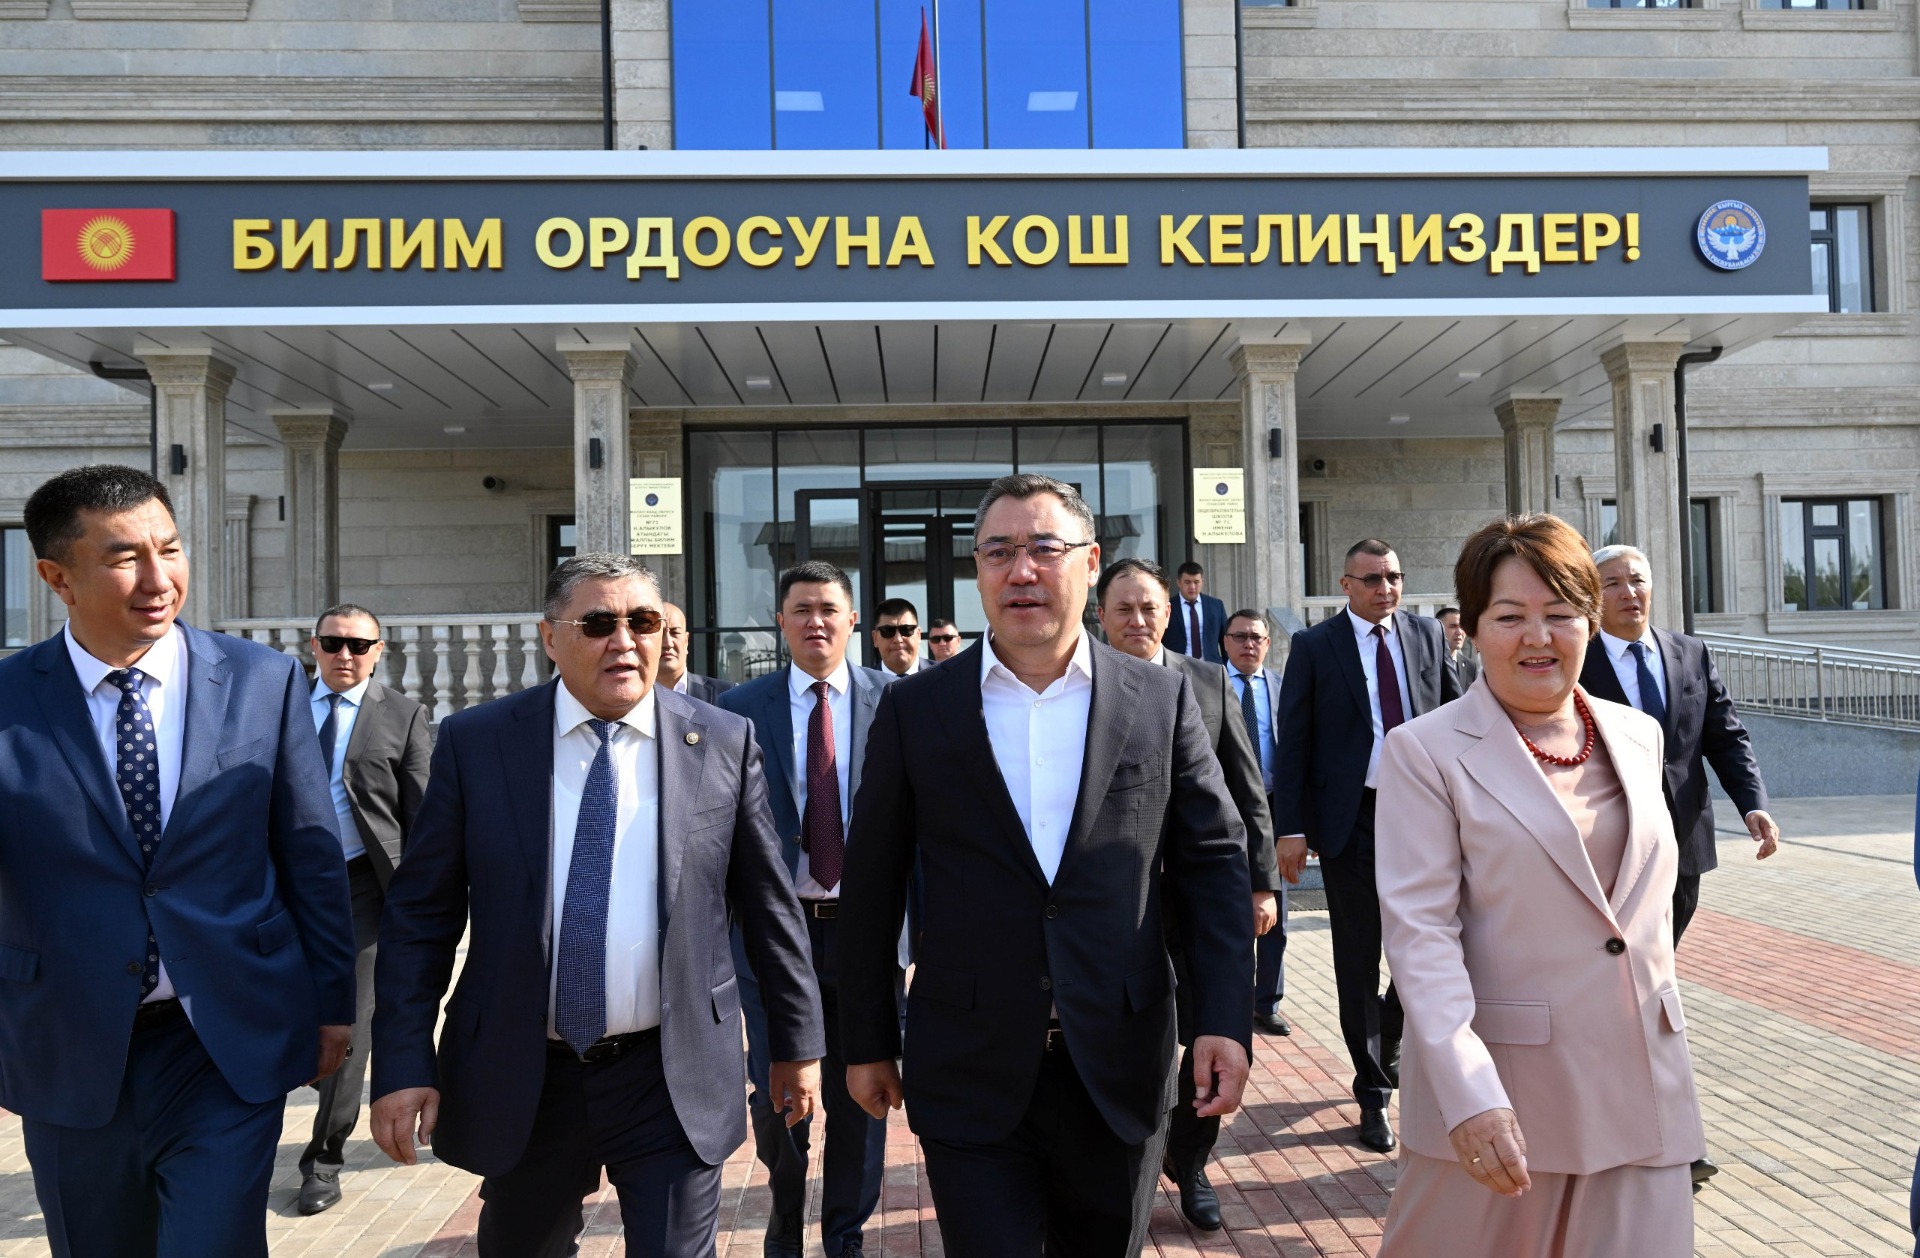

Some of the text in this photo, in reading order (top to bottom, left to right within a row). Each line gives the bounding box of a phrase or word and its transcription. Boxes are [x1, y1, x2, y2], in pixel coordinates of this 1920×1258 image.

[233, 212, 1641, 280] БИЛИМ ОРДОСУНА КОШ КЕЛИҢИЗДЕР!
